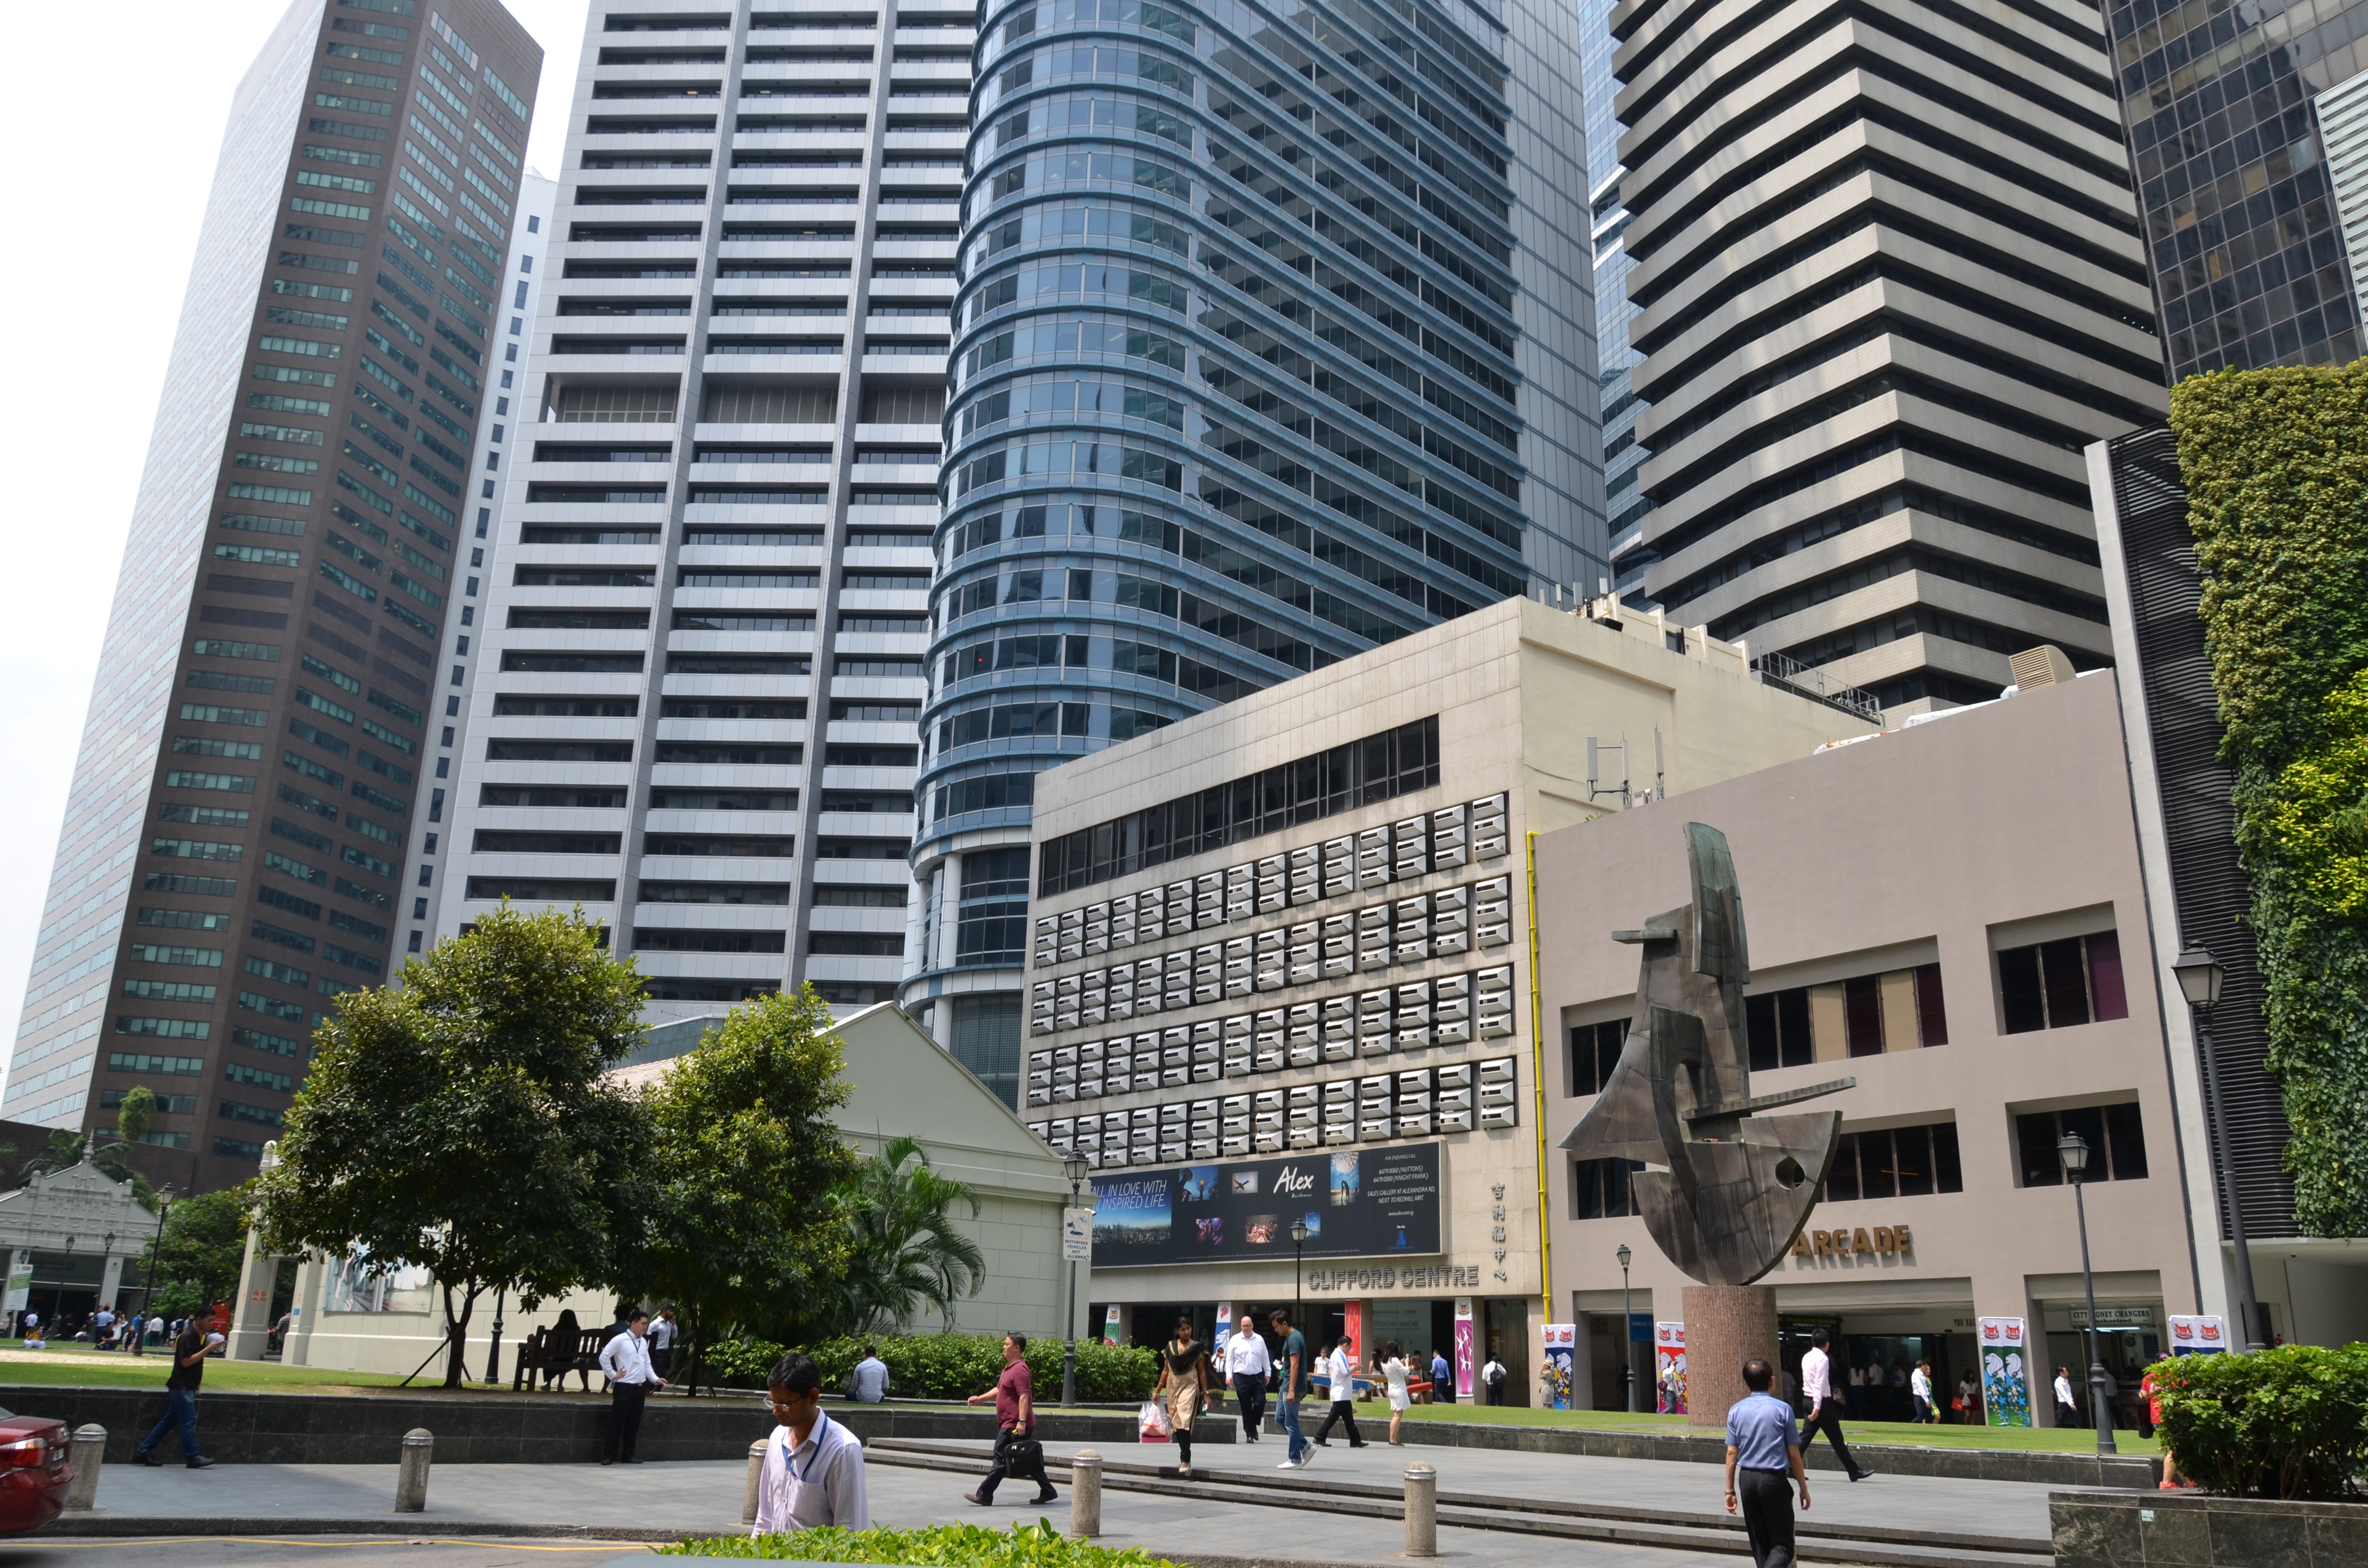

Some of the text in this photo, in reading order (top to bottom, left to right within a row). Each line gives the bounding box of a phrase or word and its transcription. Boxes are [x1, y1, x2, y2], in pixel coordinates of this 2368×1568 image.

[1393, 1174, 1412, 1183] (KNIGHT
[1399, 1165, 1423, 1174] (HUTTONS)
[1108, 1184, 1118, 1197] IN
[1119, 1182, 1141, 1196] LOVE
[1144, 1179, 1167, 1194] WITH
[1273, 1165, 1314, 1194] Alex
[1102, 1195, 1143, 1211] INSPIRED
[1145, 1193, 1165, 1208] LIFE.
[1791, 1225, 1910, 1256] ARCADE
[1308, 1265, 1479, 1289] CLIFFORD CENTRE
